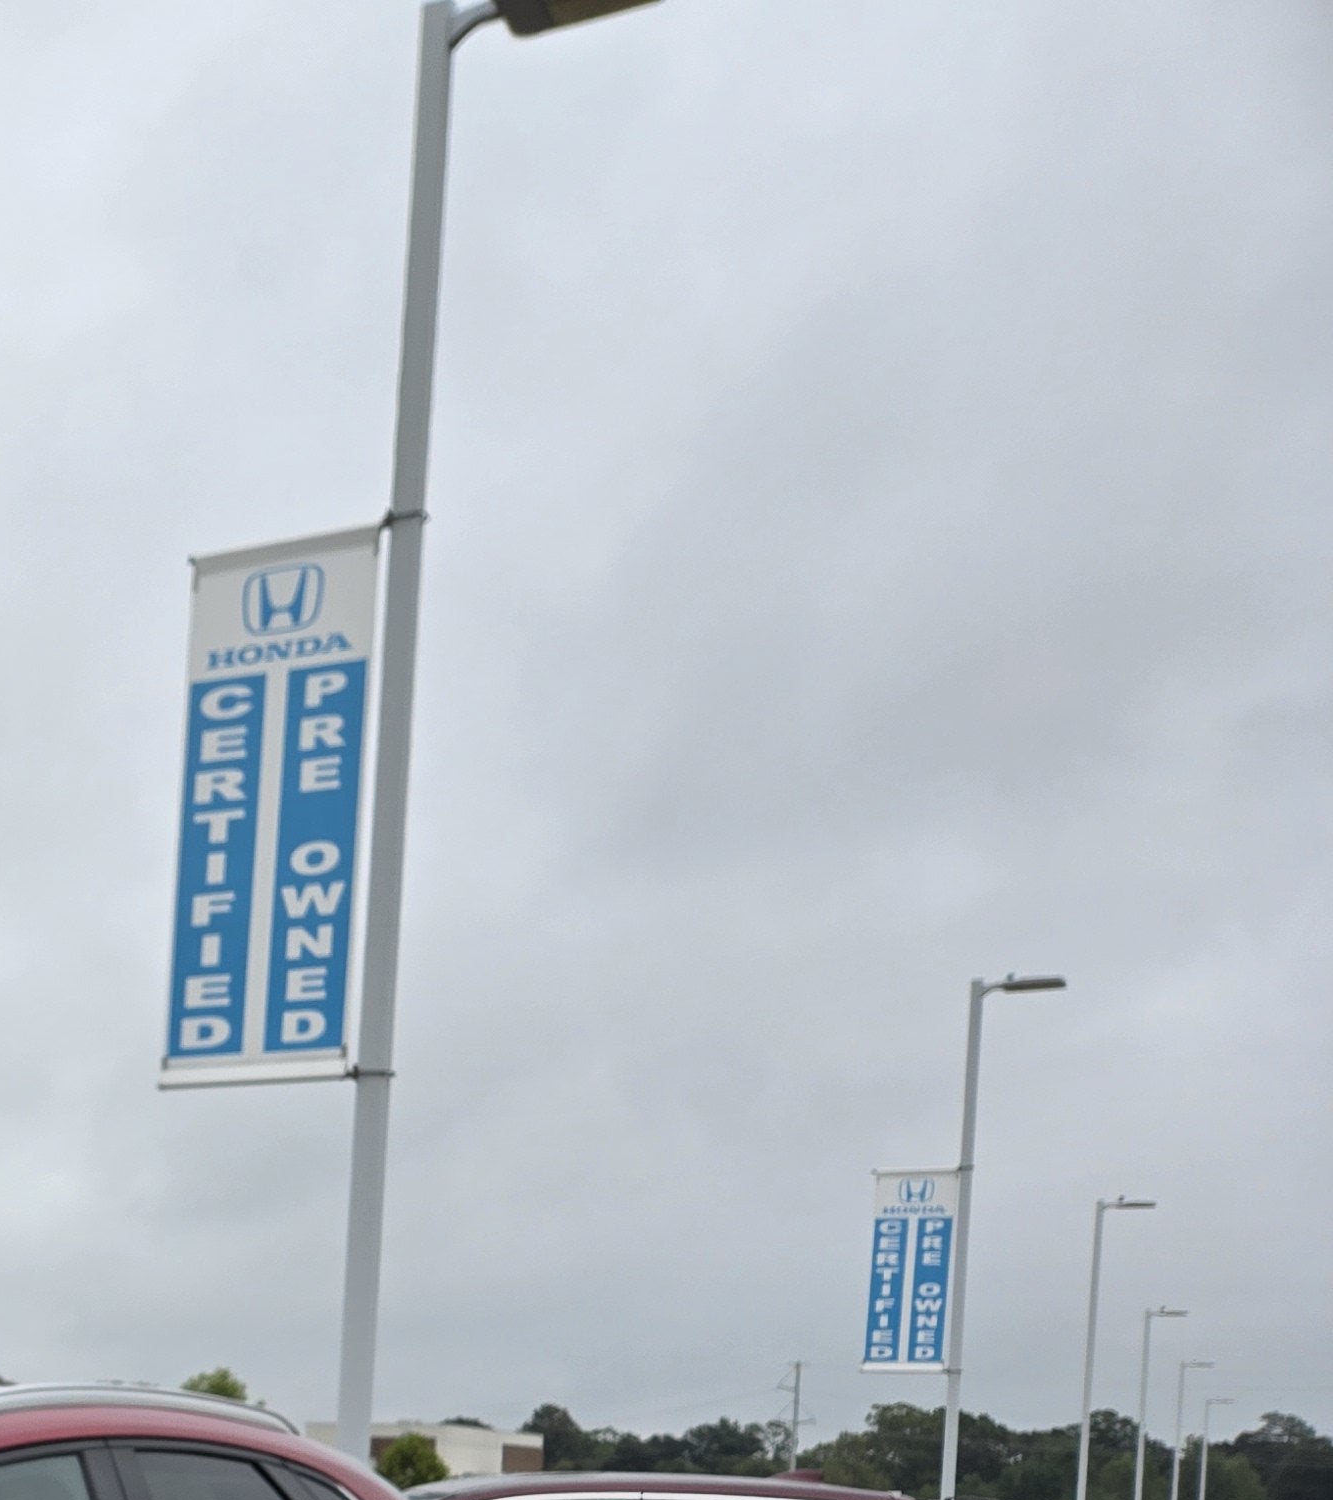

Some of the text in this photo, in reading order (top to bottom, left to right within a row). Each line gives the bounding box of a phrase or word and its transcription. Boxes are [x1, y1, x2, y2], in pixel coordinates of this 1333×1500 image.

[207, 632, 353, 670] HONDA
[179, 683, 250, 1051] CERTIFIED
[280, 669, 349, 1046] PRE OWNED
